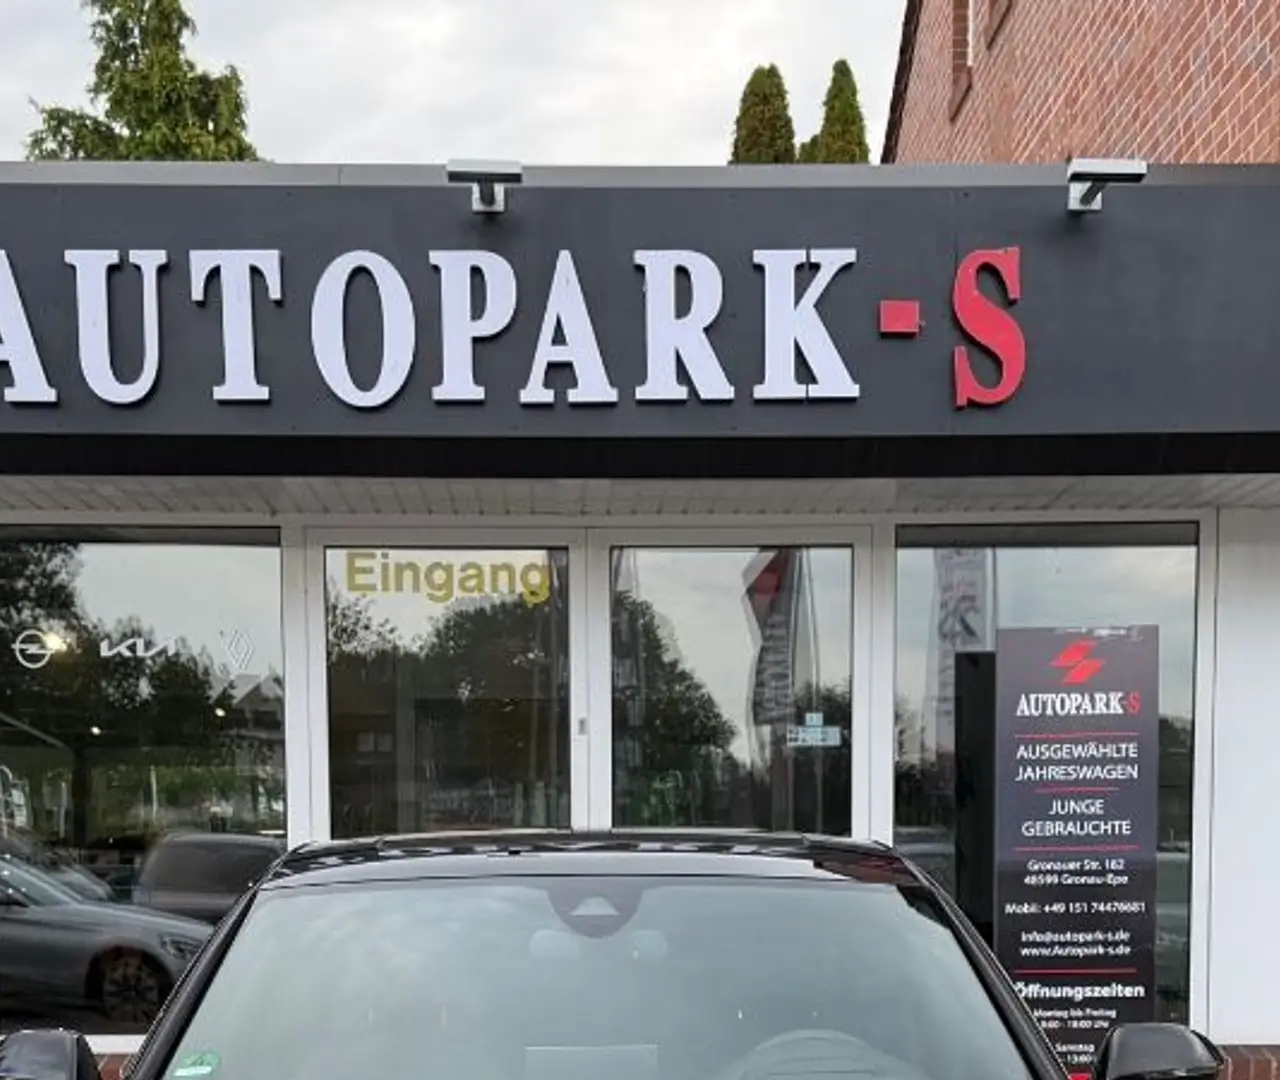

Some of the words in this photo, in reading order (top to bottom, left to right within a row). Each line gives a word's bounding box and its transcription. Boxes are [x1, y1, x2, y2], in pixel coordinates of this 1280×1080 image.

[346, 551, 551, 605] Eingang
[1016, 692, 1141, 716] AUTOPARK-S
[1016, 742, 1138, 761] AUSGEWÄHLTE
[1016, 764, 1138, 782] JAHRESWAGEN
[1049, 799, 1105, 815] JUNGE
[1021, 820, 1132, 837] GEBRAUCHTE
